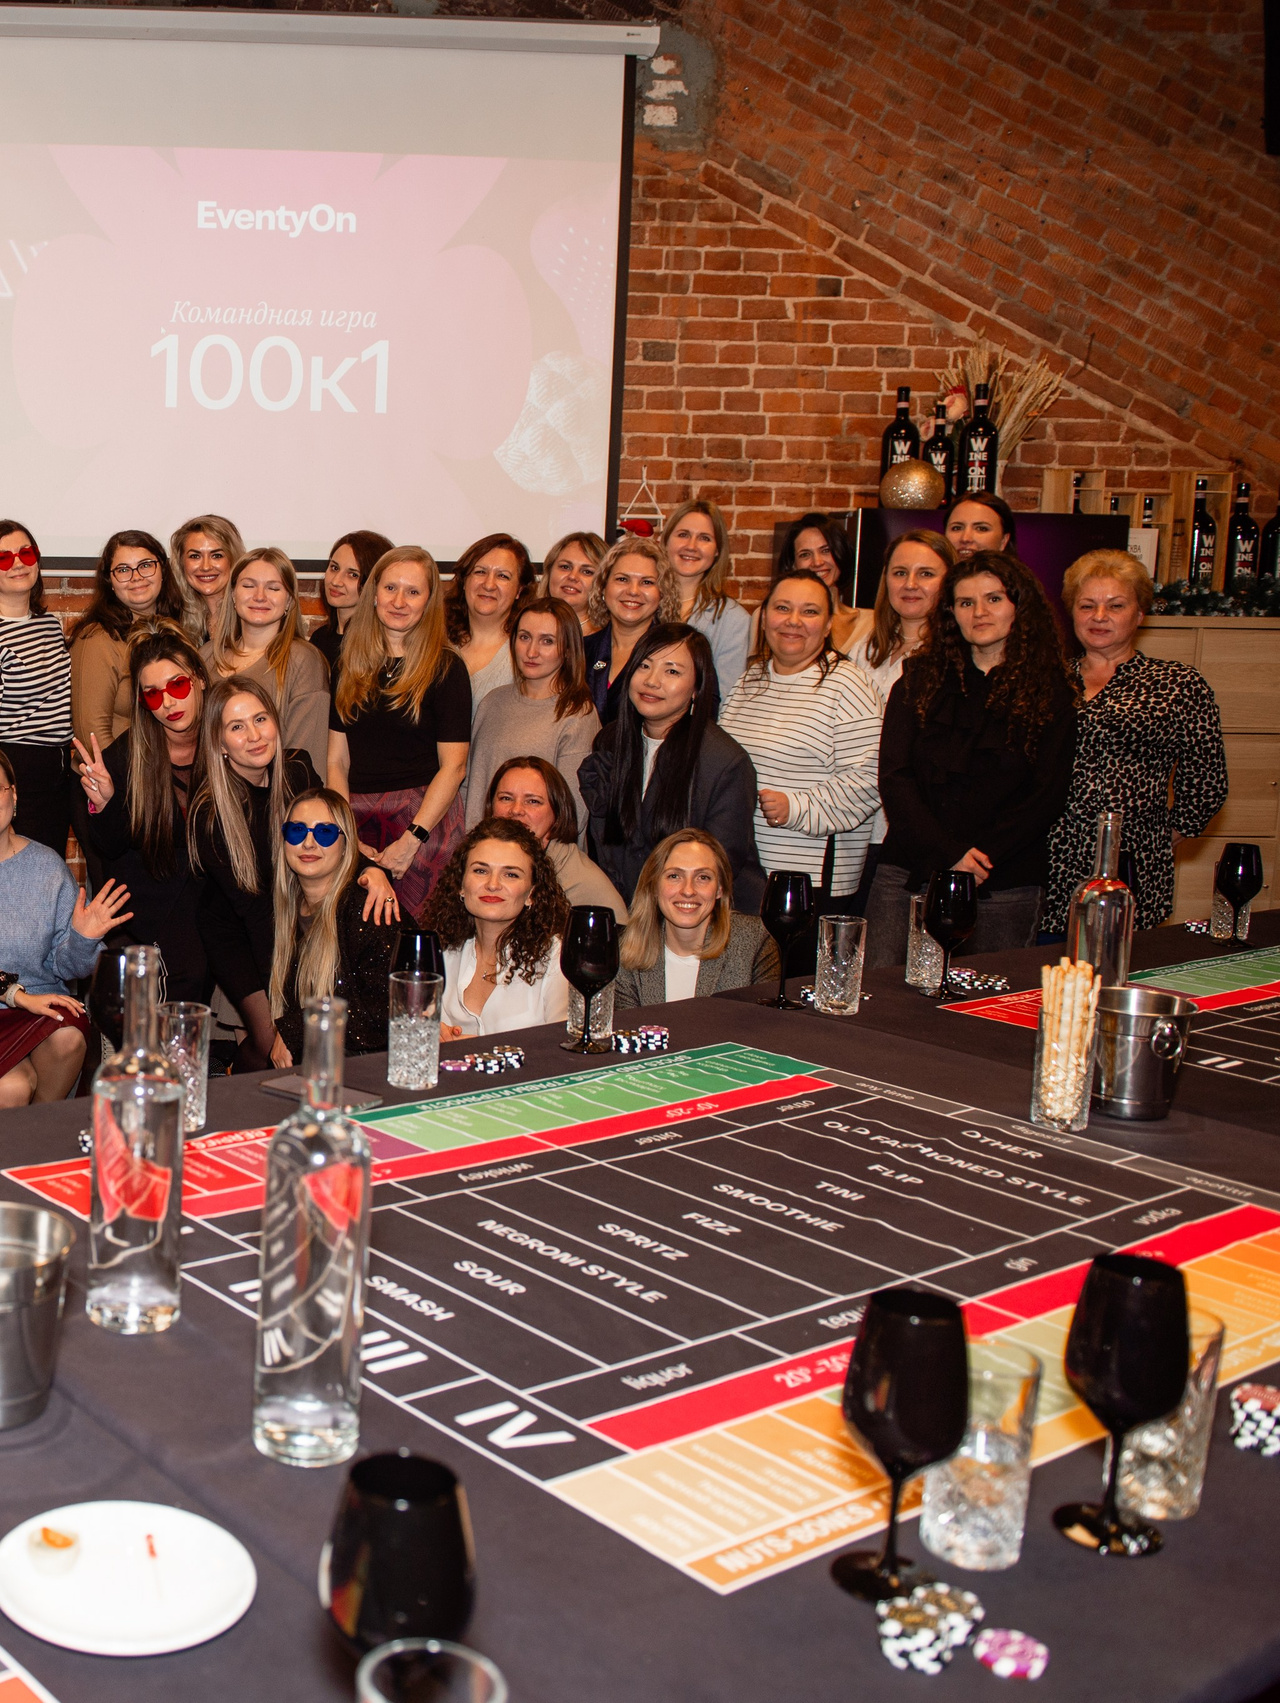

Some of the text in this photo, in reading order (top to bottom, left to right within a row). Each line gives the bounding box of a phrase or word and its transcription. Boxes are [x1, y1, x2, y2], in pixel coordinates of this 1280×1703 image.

[197, 200, 357, 238] EventyOn
[170, 301, 377, 333] Командная игра
[893, 440, 911, 454] W
[970, 437, 989, 451] W
[930, 452, 947, 465] W
[969, 452, 988, 461] INE
[968, 466, 986, 475] ON
[1200, 548, 1214, 556] INE
[1202, 534, 1215, 548] W
[1239, 540, 1255, 553] W
[1200, 561, 1213, 570] ON
[1236, 553, 1254, 561] INE
[855, 1080, 915, 1101] any time
[776, 1100, 816, 1113] other
[634, 1130, 683, 1147] bitter
[961, 1129, 1045, 1160] OTHER
[457, 1162, 535, 1183] whiskey
[823, 1120, 871, 1137] OLD
[1004, 1175, 1092, 1207] STYLE
[866, 1163, 925, 1185] FLIP
[814, 1180, 867, 1202] TINI
[1185, 1174, 1256, 1199] aperitif
[712, 1183, 845, 1232] SMOOTHIE
[1132, 1206, 1184, 1227] vodka
[680, 1211, 742, 1236] FIZZ
[597, 1222, 689, 1261] SPRITZ
[476, 1218, 669, 1304] NEGRONI STYLE
[1003, 1256, 1039, 1273] gin
[453, 1259, 527, 1296] SOUR
[365, 1274, 456, 1322] SMASH
[817, 1305, 868, 1330] tequ
[620, 1362, 693, 1390] liquor
[454, 1400, 577, 1449] IV
[714, 1499, 876, 1574] NUTS-BONES
